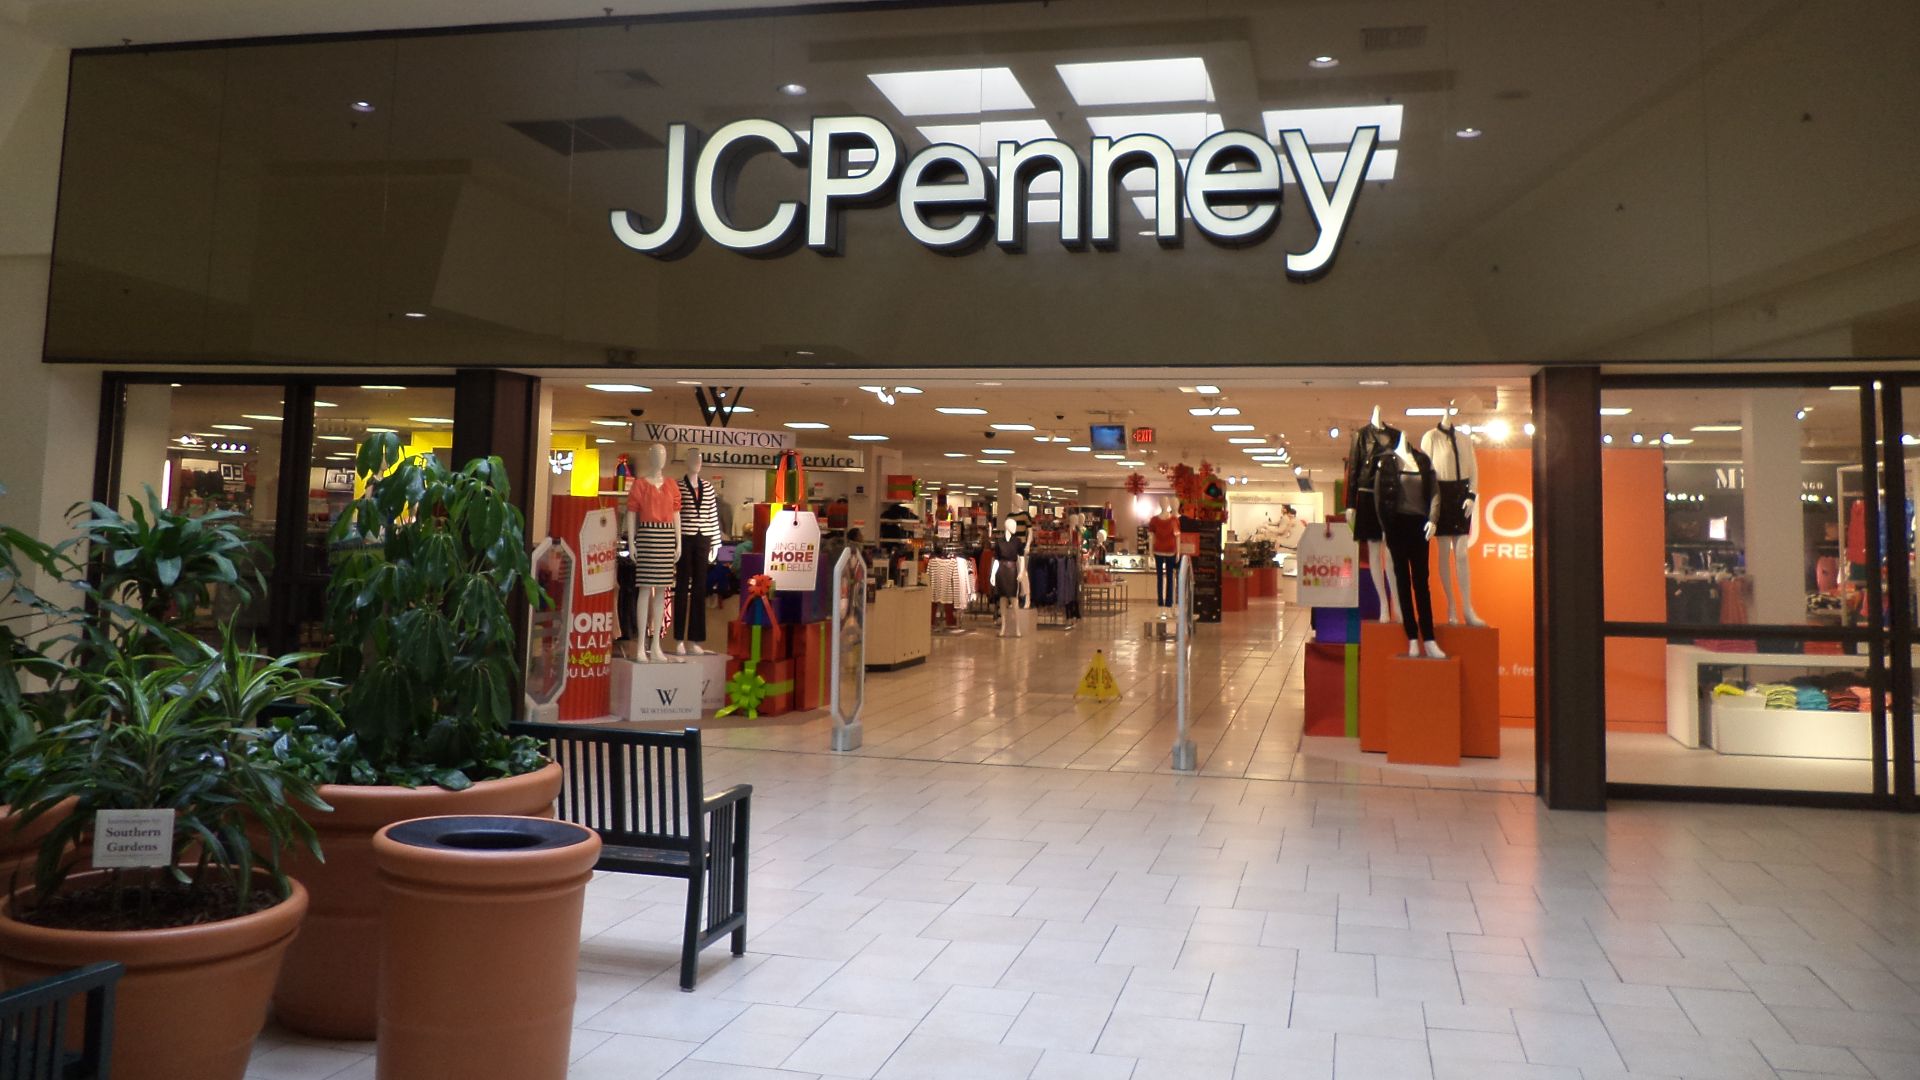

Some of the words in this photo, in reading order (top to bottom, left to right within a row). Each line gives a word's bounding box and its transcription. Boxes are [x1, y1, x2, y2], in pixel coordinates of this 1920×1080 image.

[610, 115, 1381, 278] JCPenney
[1136, 429, 1153, 442] EXIT
[688, 448, 777, 466] ustomer
[795, 453, 855, 468] ervice
[774, 542, 807, 551] JINGLE
[1483, 543, 1534, 559] FRE
[771, 551, 814, 562] MORE
[787, 563, 814, 572] BELLS
[105, 826, 162, 838] Southern
[106, 841, 158, 853] Gardens
